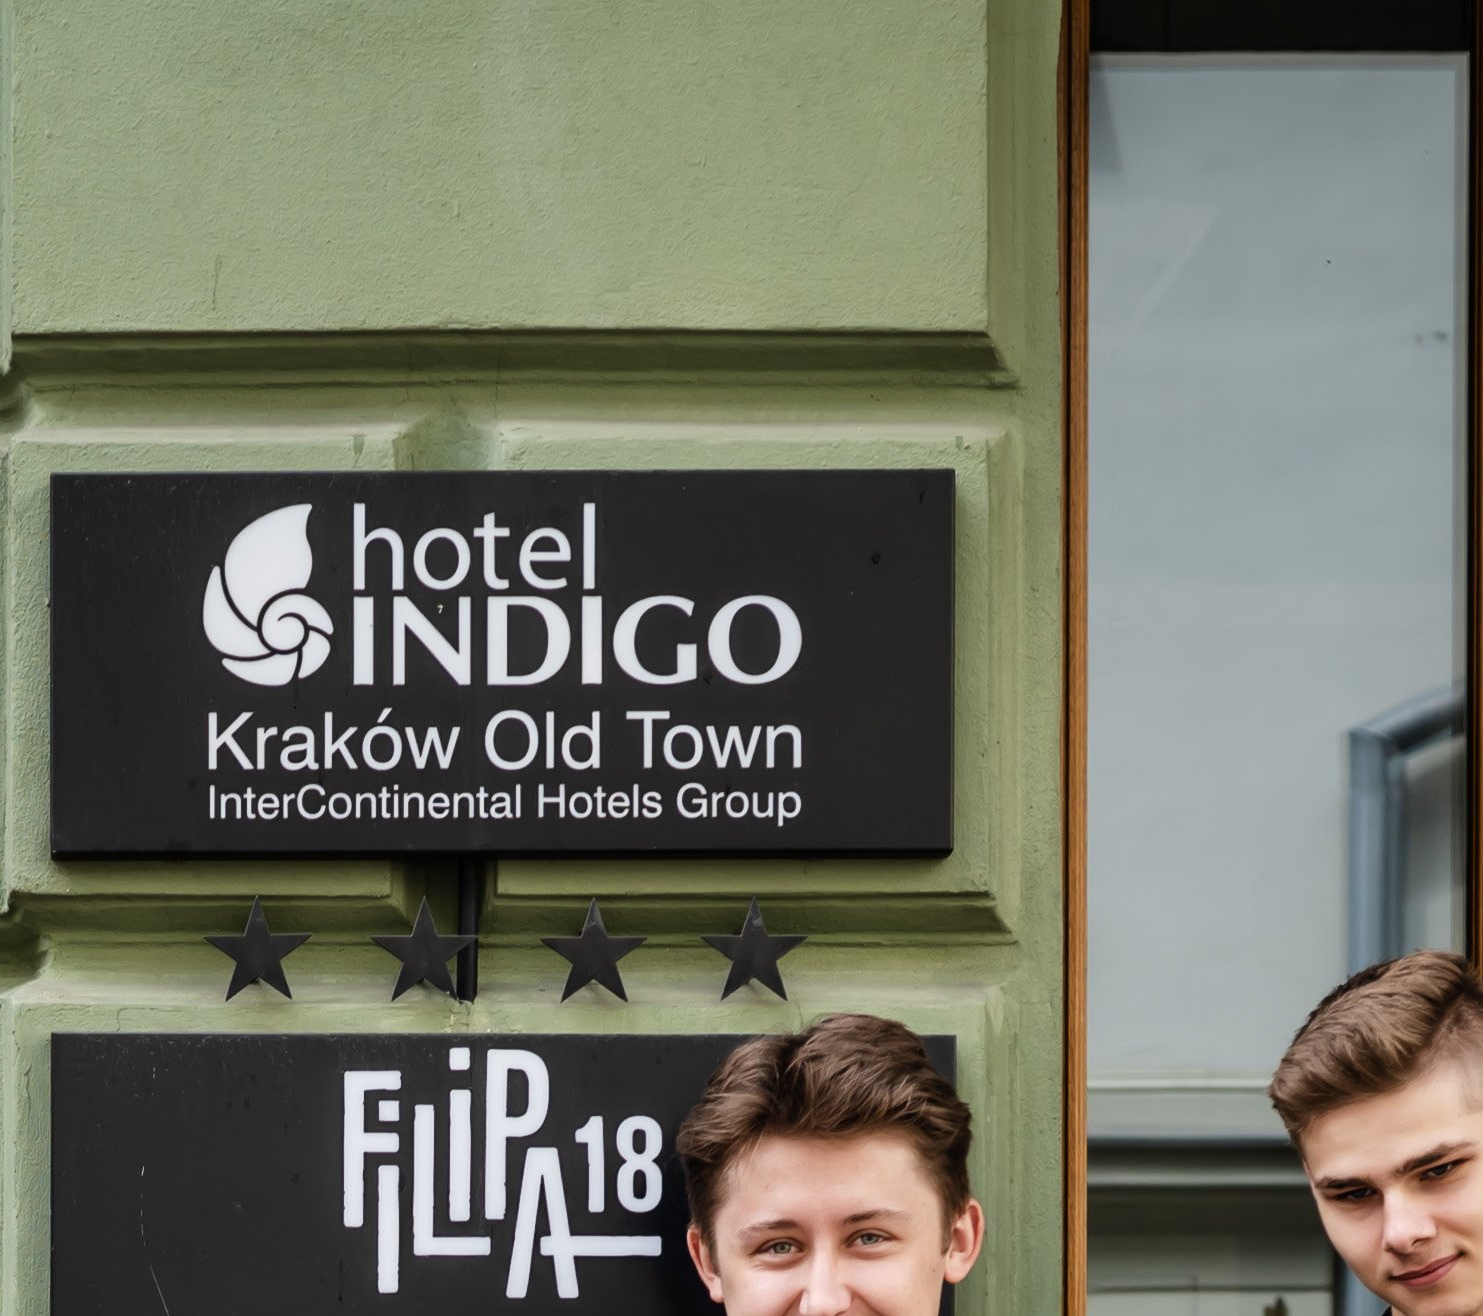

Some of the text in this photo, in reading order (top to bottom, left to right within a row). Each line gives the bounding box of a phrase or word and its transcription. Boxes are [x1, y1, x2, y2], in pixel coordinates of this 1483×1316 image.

[353, 503, 596, 590] hotel
[353, 595, 803, 686] INDIGO
[208, 708, 802, 771] Kraków Old Town
[209, 784, 801, 827] InterContinental Hotels Group
[575, 1115, 663, 1213] 18
